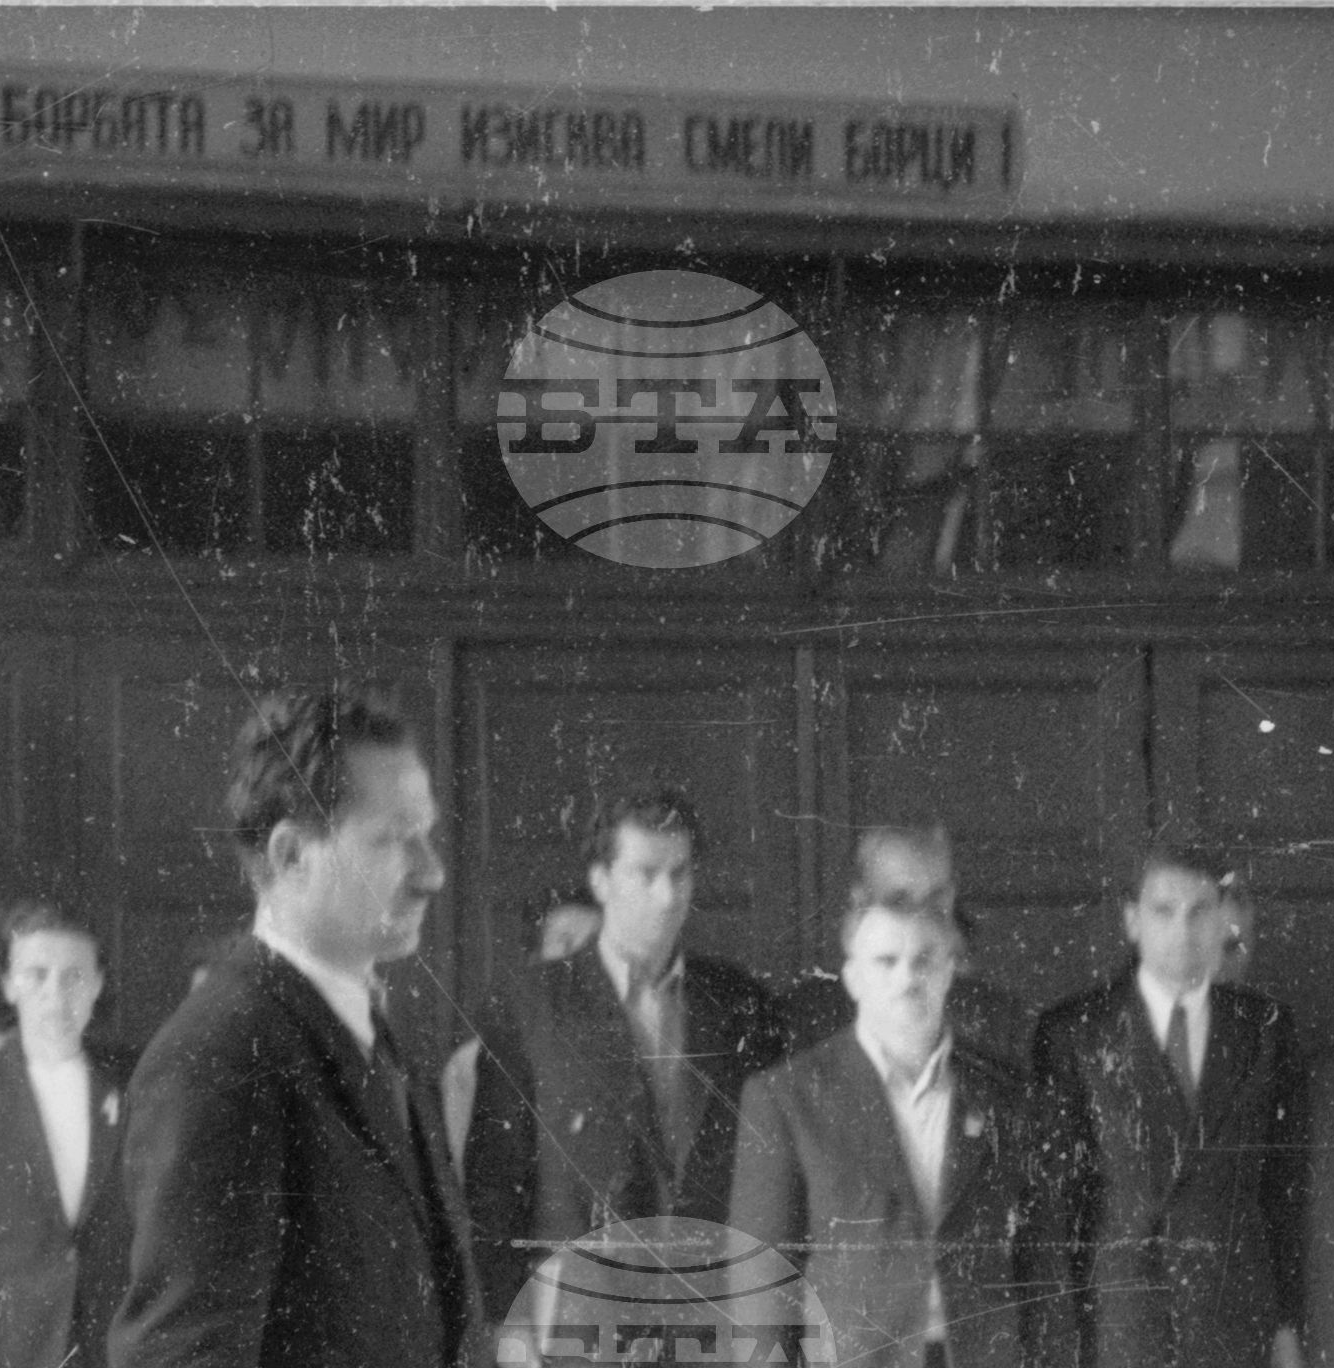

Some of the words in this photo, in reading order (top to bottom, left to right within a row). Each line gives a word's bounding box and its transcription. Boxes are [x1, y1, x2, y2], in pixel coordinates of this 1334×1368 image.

[1, 84, 207, 158] БОРБАТА
[240, 98, 295, 160] ЗА
[325, 98, 427, 166] МИР
[460, 102, 644, 172] ИЗИСКВА
[684, 114, 815, 180] СМЕЛИ
